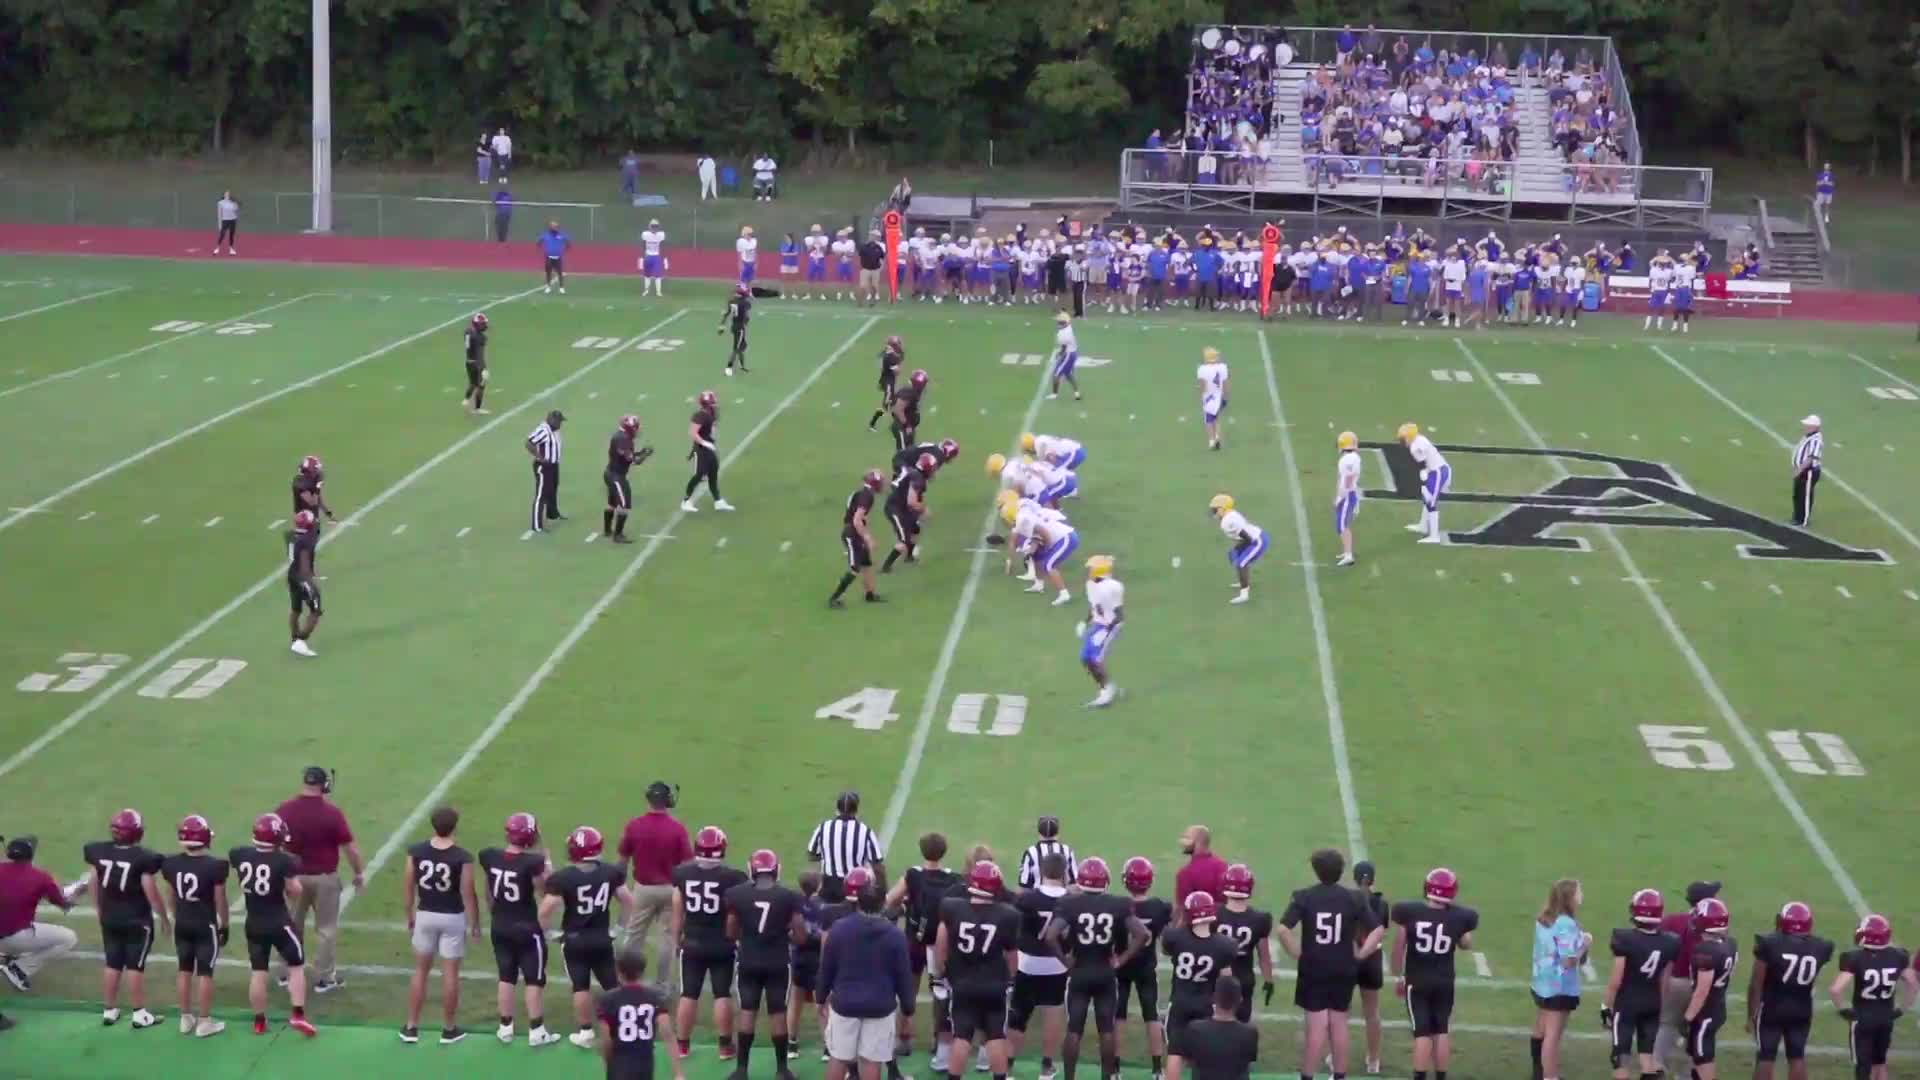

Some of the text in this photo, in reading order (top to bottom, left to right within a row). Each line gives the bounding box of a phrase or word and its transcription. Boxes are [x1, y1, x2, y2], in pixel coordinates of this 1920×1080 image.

[98, 859, 131, 893] 77
[175, 871, 200, 902] 12
[239, 861, 271, 896] 28
[418, 860, 452, 892] 23
[490, 867, 521, 903] 75
[576, 881, 610, 915] 54
[685, 881, 720, 914] 55
[754, 901, 772, 934] 7
[1037, 911, 1054, 941] 7
[1077, 913, 1114, 944] 33
[1315, 913, 1342, 944] 51
[959, 922, 997, 955] 57
[1416, 921, 1451, 954] 56
[1176, 952, 1213, 982] 82
[1640, 951, 1661, 977] 4
[1782, 954, 1816, 985] 70
[1862, 968, 1896, 999] 25
[617, 1003, 655, 1042] 83
